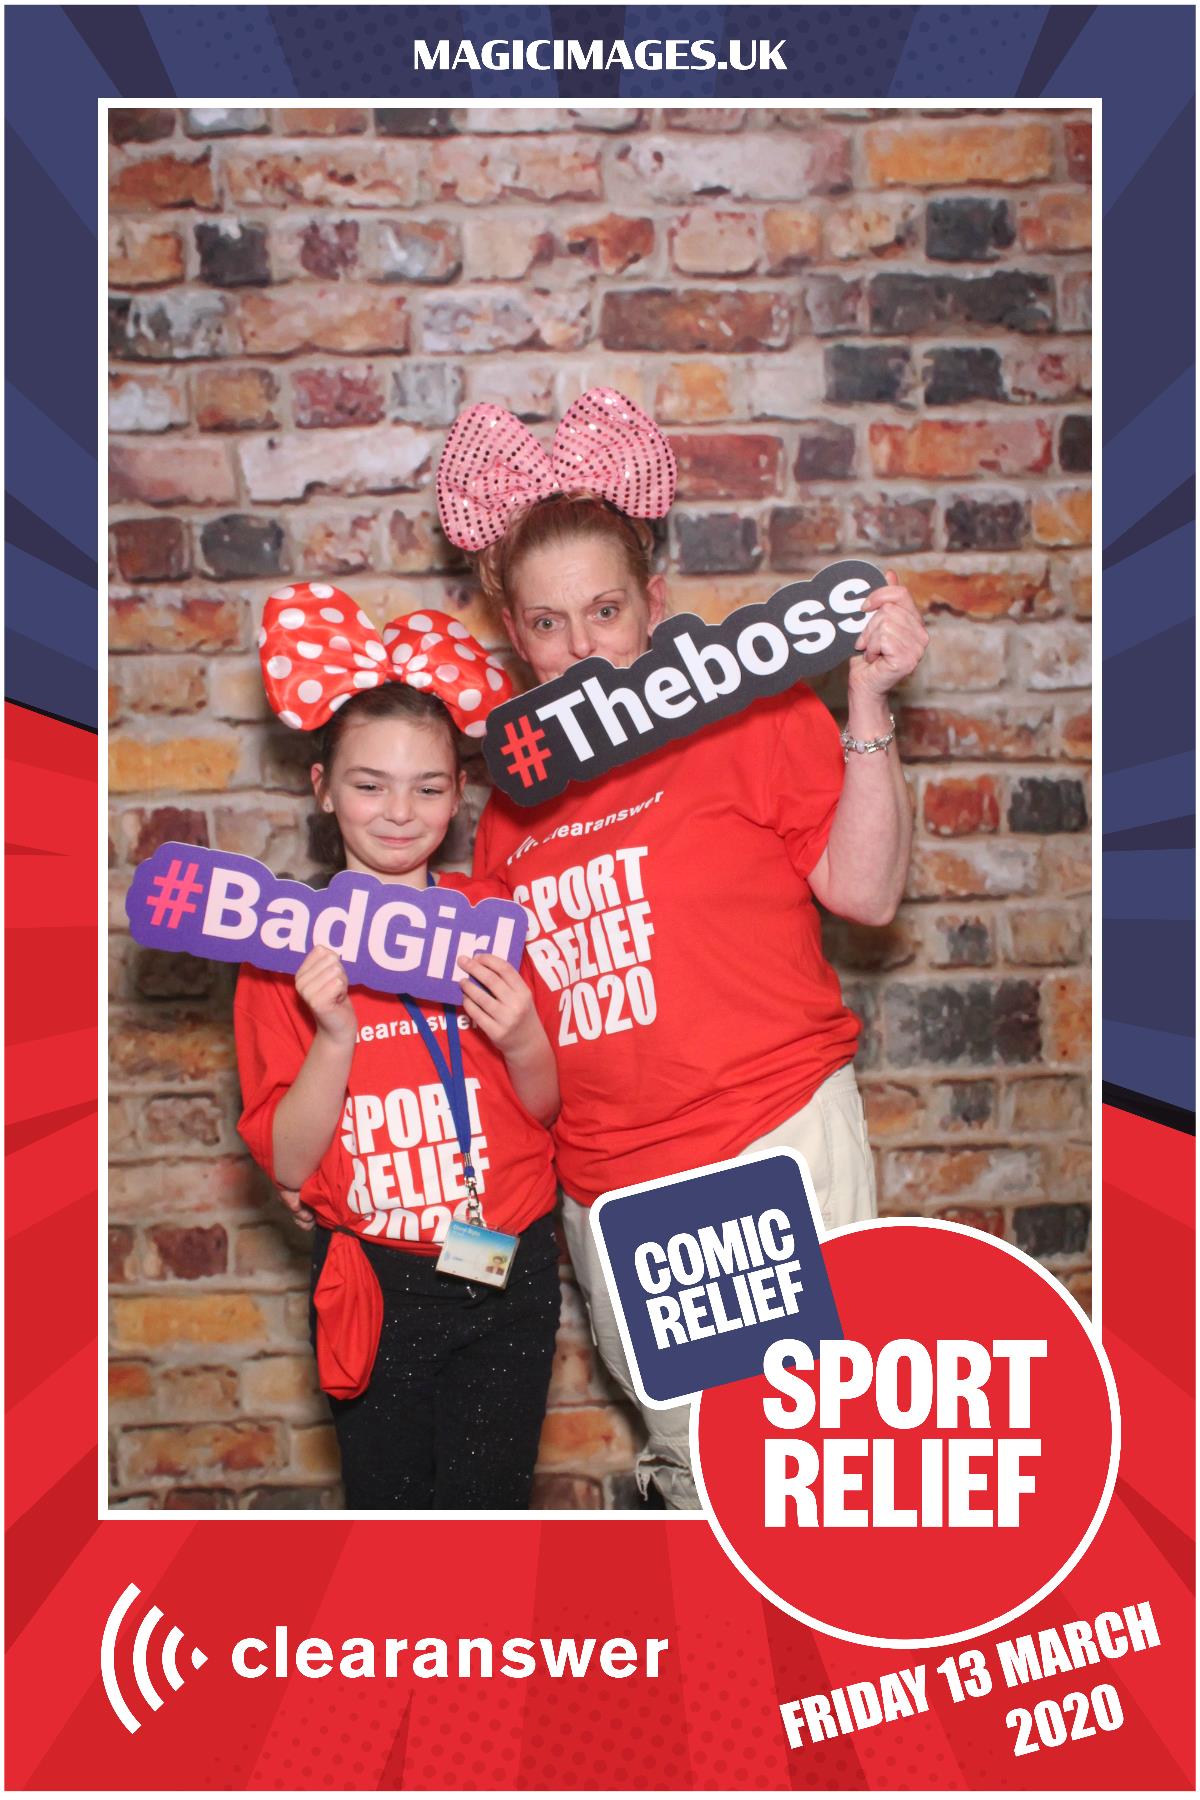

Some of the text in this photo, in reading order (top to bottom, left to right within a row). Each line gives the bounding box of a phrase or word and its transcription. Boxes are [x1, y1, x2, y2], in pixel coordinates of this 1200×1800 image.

[500, 578, 873, 789] #Theboss
[146, 859, 516, 983] #BadGirl
[512, 846, 649, 942] SPORT
[526, 901, 656, 993] RELIEF
[558, 966, 658, 1047] 2020
[341, 1077, 483, 1156] SPORT
[347, 1135, 491, 1215] RELIEF
